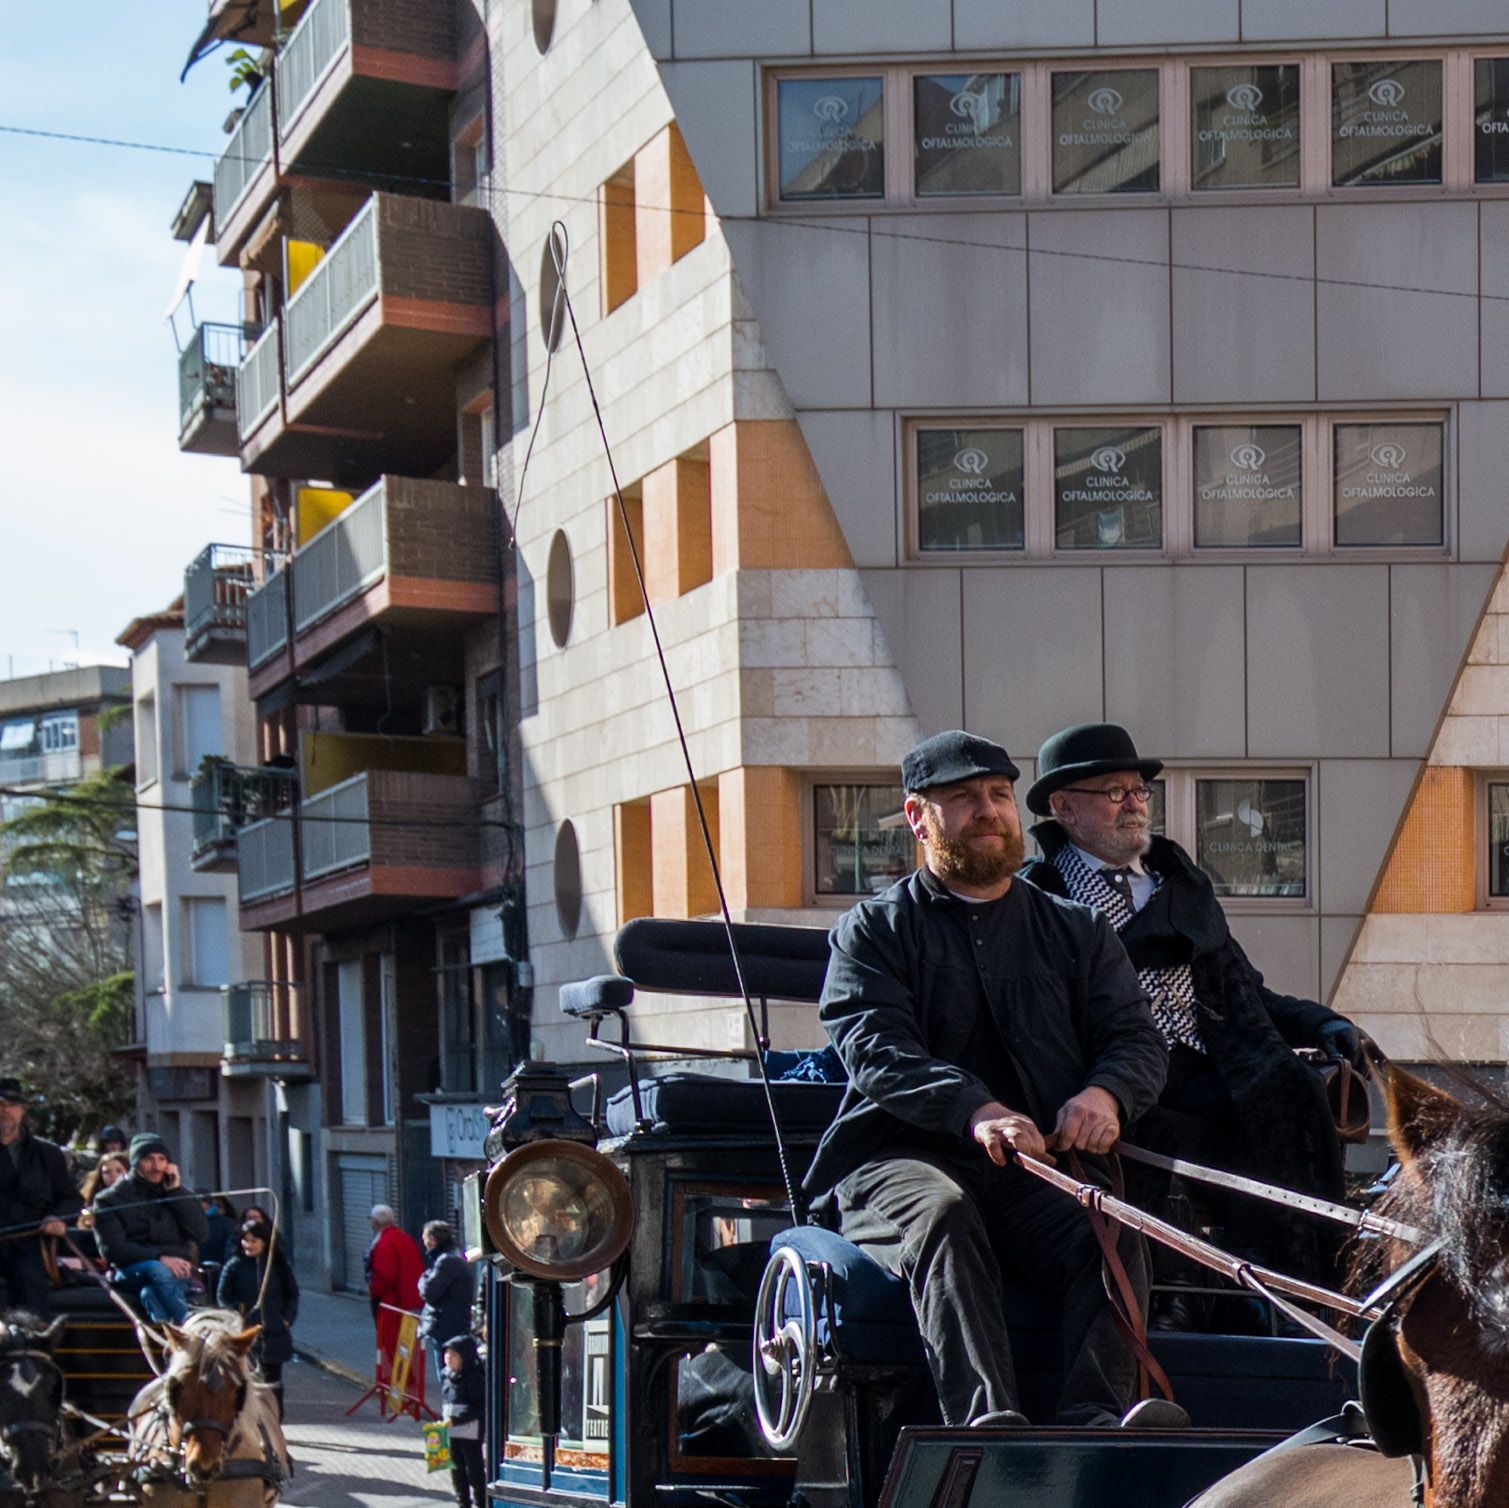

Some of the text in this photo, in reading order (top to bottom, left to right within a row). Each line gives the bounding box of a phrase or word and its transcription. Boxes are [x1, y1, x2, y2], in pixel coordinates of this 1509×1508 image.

[1223, 115, 1268, 126] CLINICA
[1364, 111, 1409, 122] CLINICA
[1083, 119, 1127, 130] CLINICA
[1199, 128, 1293, 141] OFTALMOLOGICA
[1340, 125, 1434, 137] OFTALMOLOGICA
[922, 136, 1012, 149] OFTALMOLOGICA
[949, 478, 992, 489] CLINICA
[1086, 476, 1129, 487] CLINICA
[1226, 474, 1270, 485] CLINICA
[1366, 473, 1410, 483] CLINICA
[926, 491, 1016, 503] OFTALMOLOGICA
[1062, 490, 1153, 501] OFTALMOLOGICA
[1202, 488, 1294, 500] OFTALMOLOGICA
[1342, 486, 1435, 498] OFTALMOLOGICA
[1209, 842, 1253, 852] CLINICA
